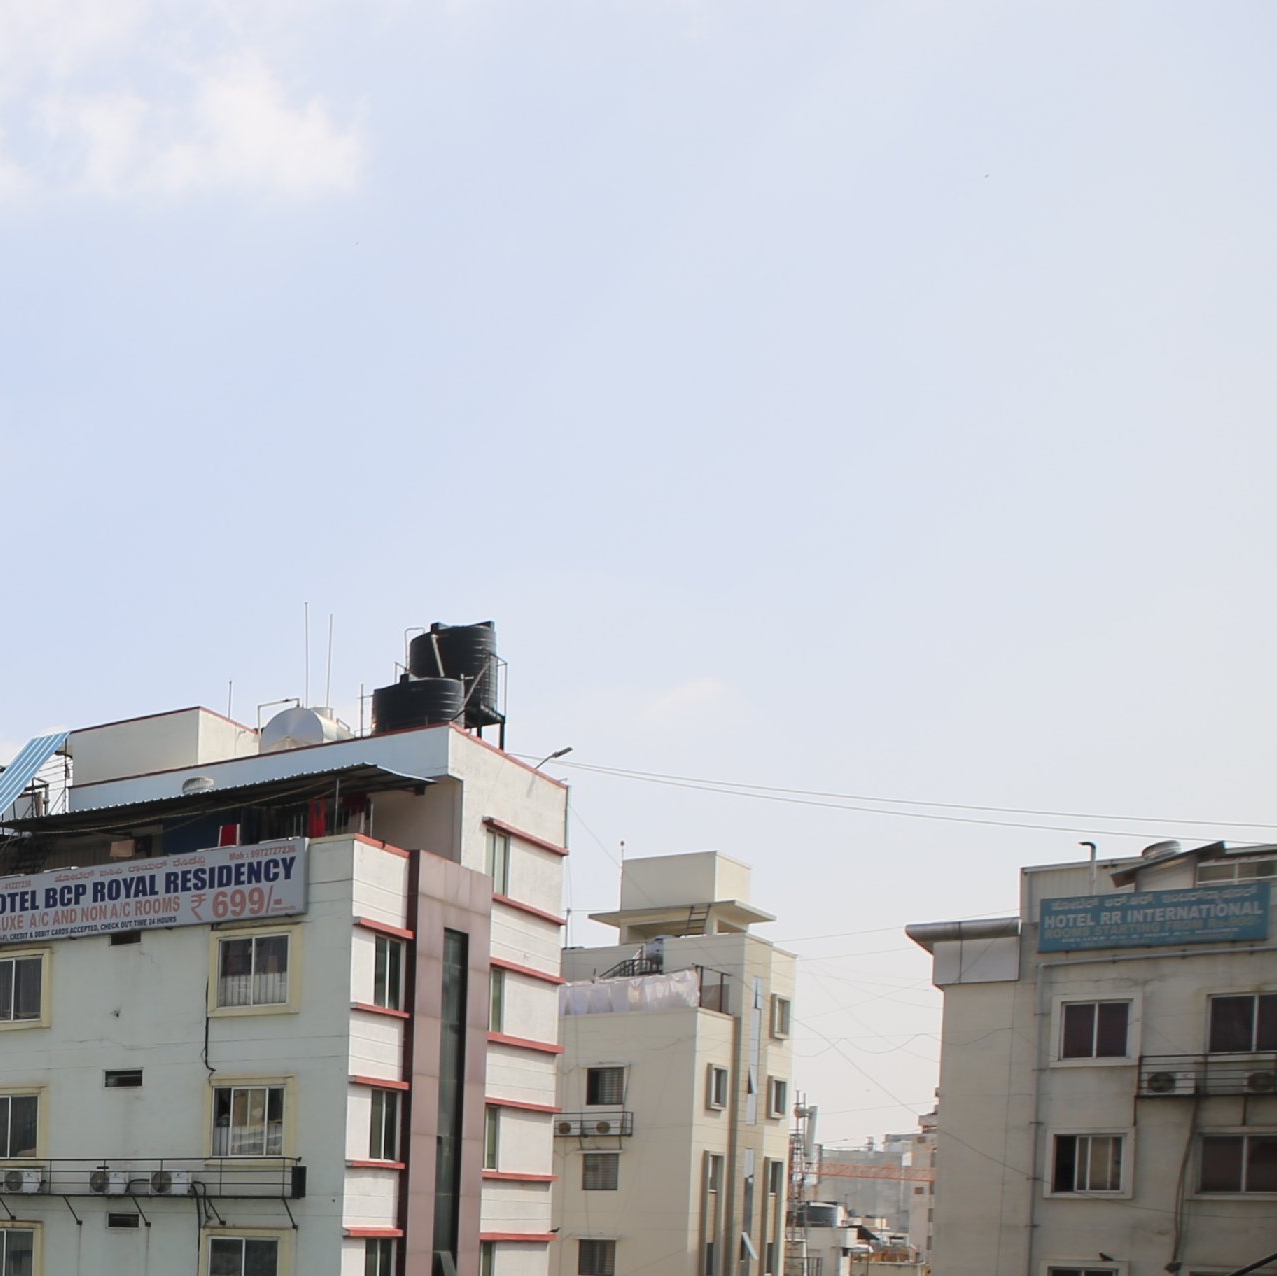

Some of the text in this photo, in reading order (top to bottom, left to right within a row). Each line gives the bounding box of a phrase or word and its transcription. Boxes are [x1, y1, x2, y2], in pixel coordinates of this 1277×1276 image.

[44, 883, 87, 909] BCP
[92, 874, 159, 904] ROYAL
[164, 855, 297, 894] RESIDENCY
[29, 911, 49, 929] A/C
[52, 908, 77, 926] AND
[81, 904, 108, 922] NON
[110, 901, 131, 919] A/C
[134, 895, 180, 916] ROOMS
[212, 885, 283, 919] 699/-
[1044, 912, 1096, 929] HOTEL
[1099, 911, 1122, 925] RR
[1126, 900, 1264, 923] INTERNATIONAL
[100, 922, 120, 931] CHECK
[121, 920, 132, 929] OUT
[133, 918, 147, 927] TIME
[157, 916, 177, 925] HOURS
